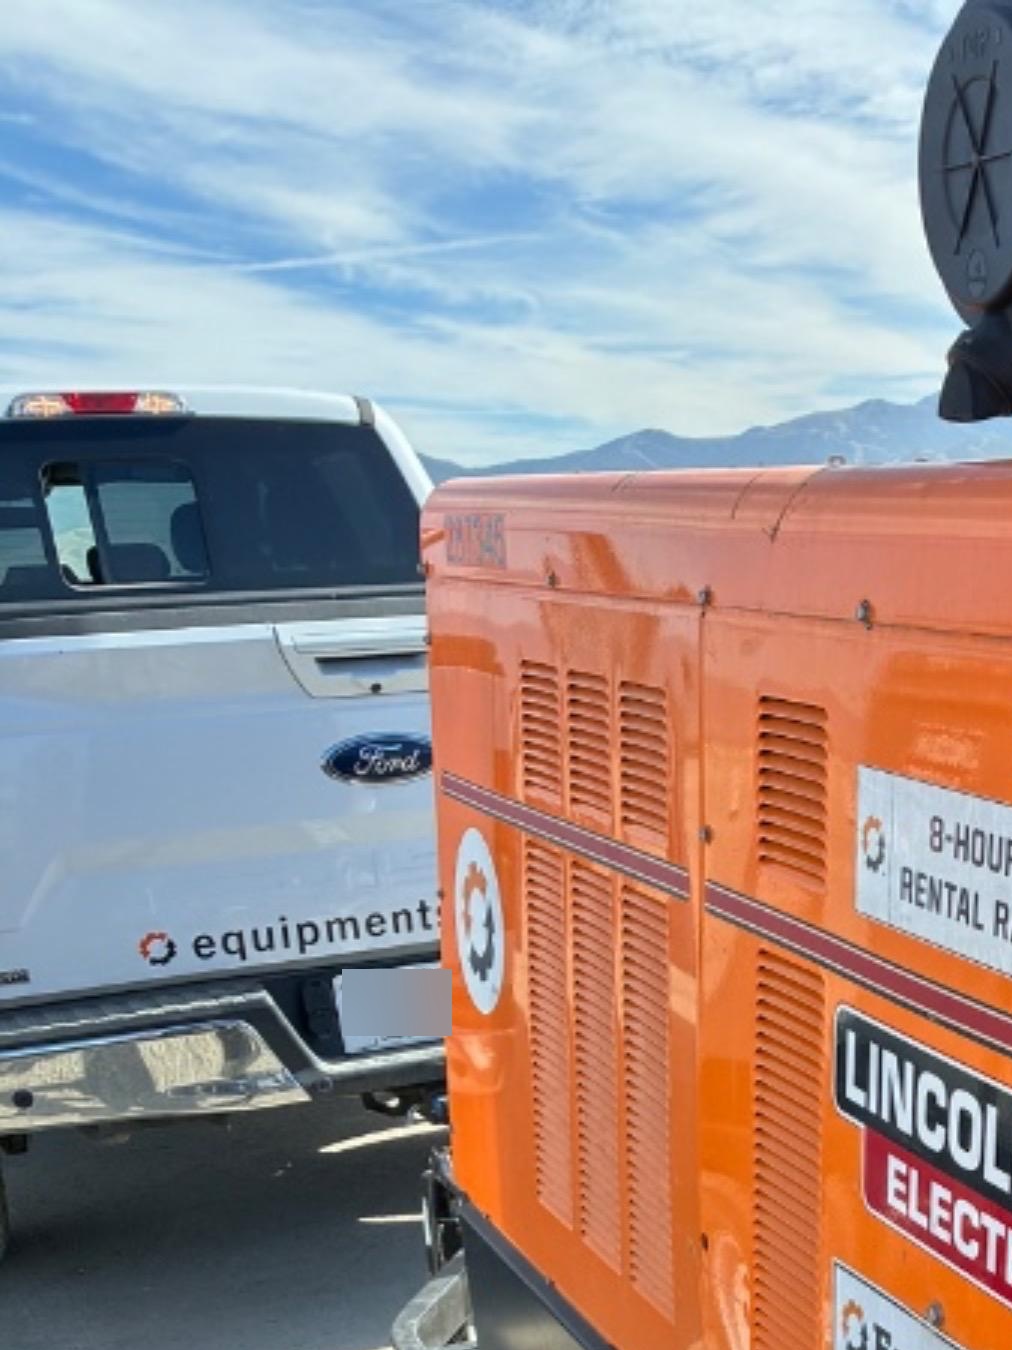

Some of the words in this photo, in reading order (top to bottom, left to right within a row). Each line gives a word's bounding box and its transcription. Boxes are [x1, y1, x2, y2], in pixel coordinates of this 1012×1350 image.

[352, 742, 421, 776] Ford
[192, 898, 441, 961] equipment
[901, 866, 984, 932] RENTAL
